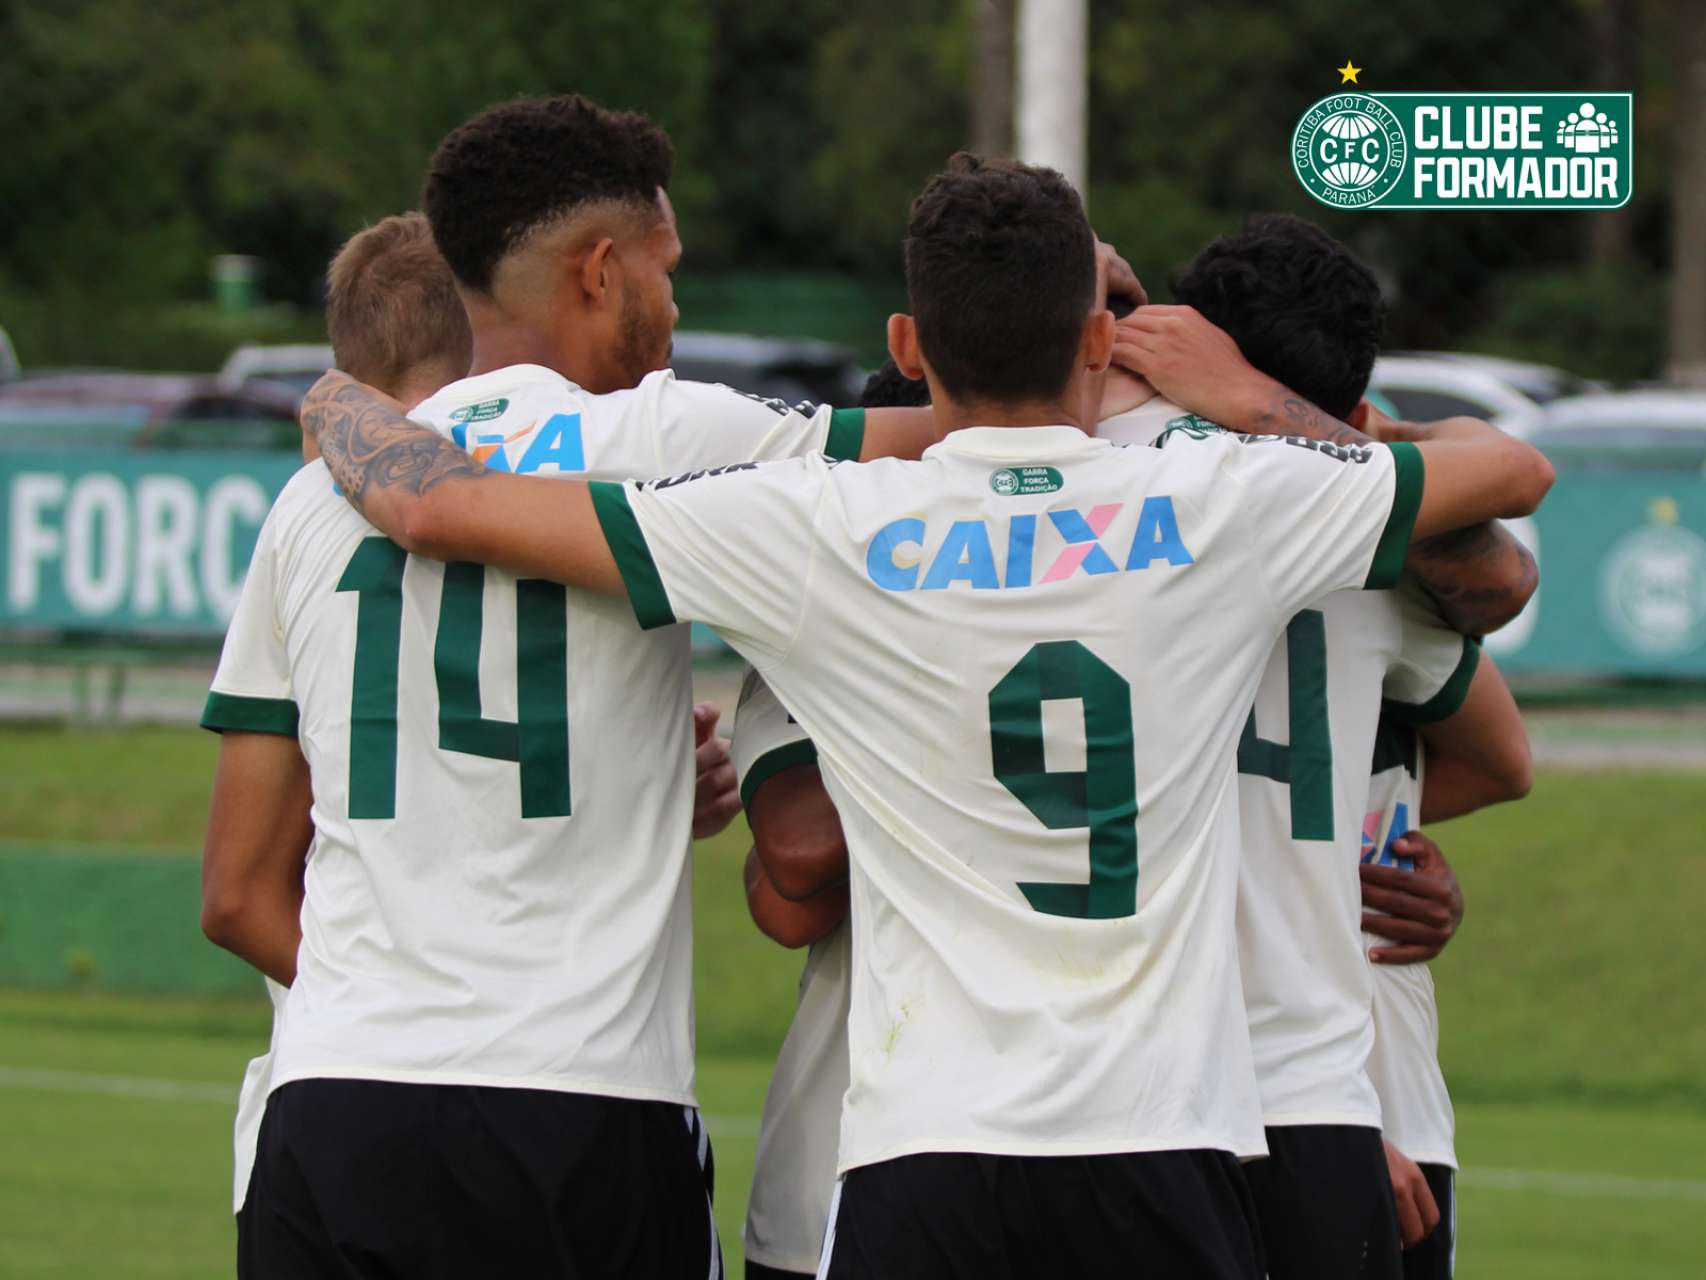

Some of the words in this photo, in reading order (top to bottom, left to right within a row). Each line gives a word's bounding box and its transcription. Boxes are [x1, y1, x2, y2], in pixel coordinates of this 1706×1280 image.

[335, 535, 572, 819] 14
[867, 495, 1195, 592] CAIXA
[988, 640, 1138, 919] 9
